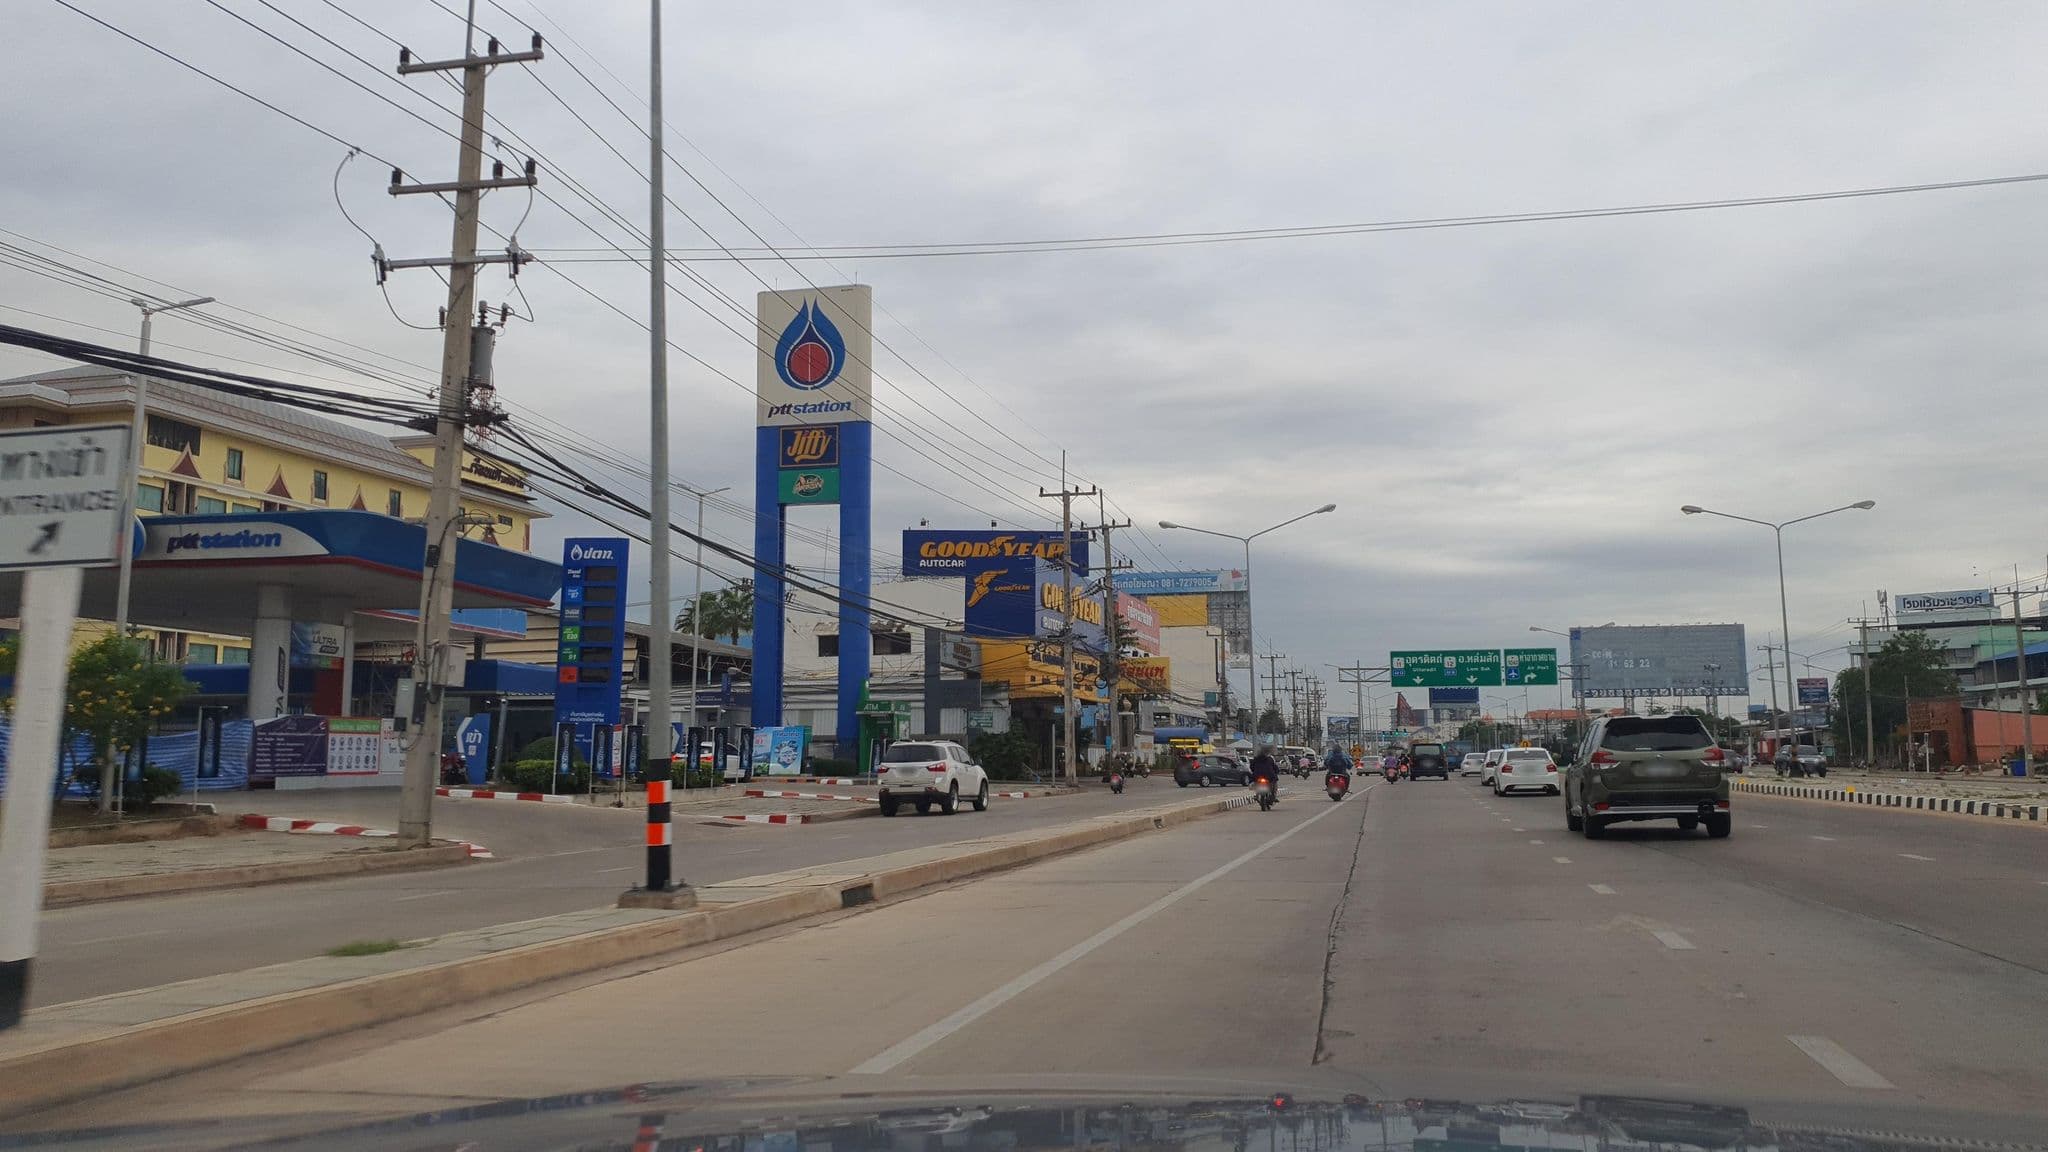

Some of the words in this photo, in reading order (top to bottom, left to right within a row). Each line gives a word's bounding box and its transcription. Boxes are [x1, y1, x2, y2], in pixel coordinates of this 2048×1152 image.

[787, 429, 832, 463] Jiffy
[0, 489, 118, 516] NTRANCE
[919, 559, 966, 568] AUTOCAR
[312, 635, 337, 645] ULTRA
